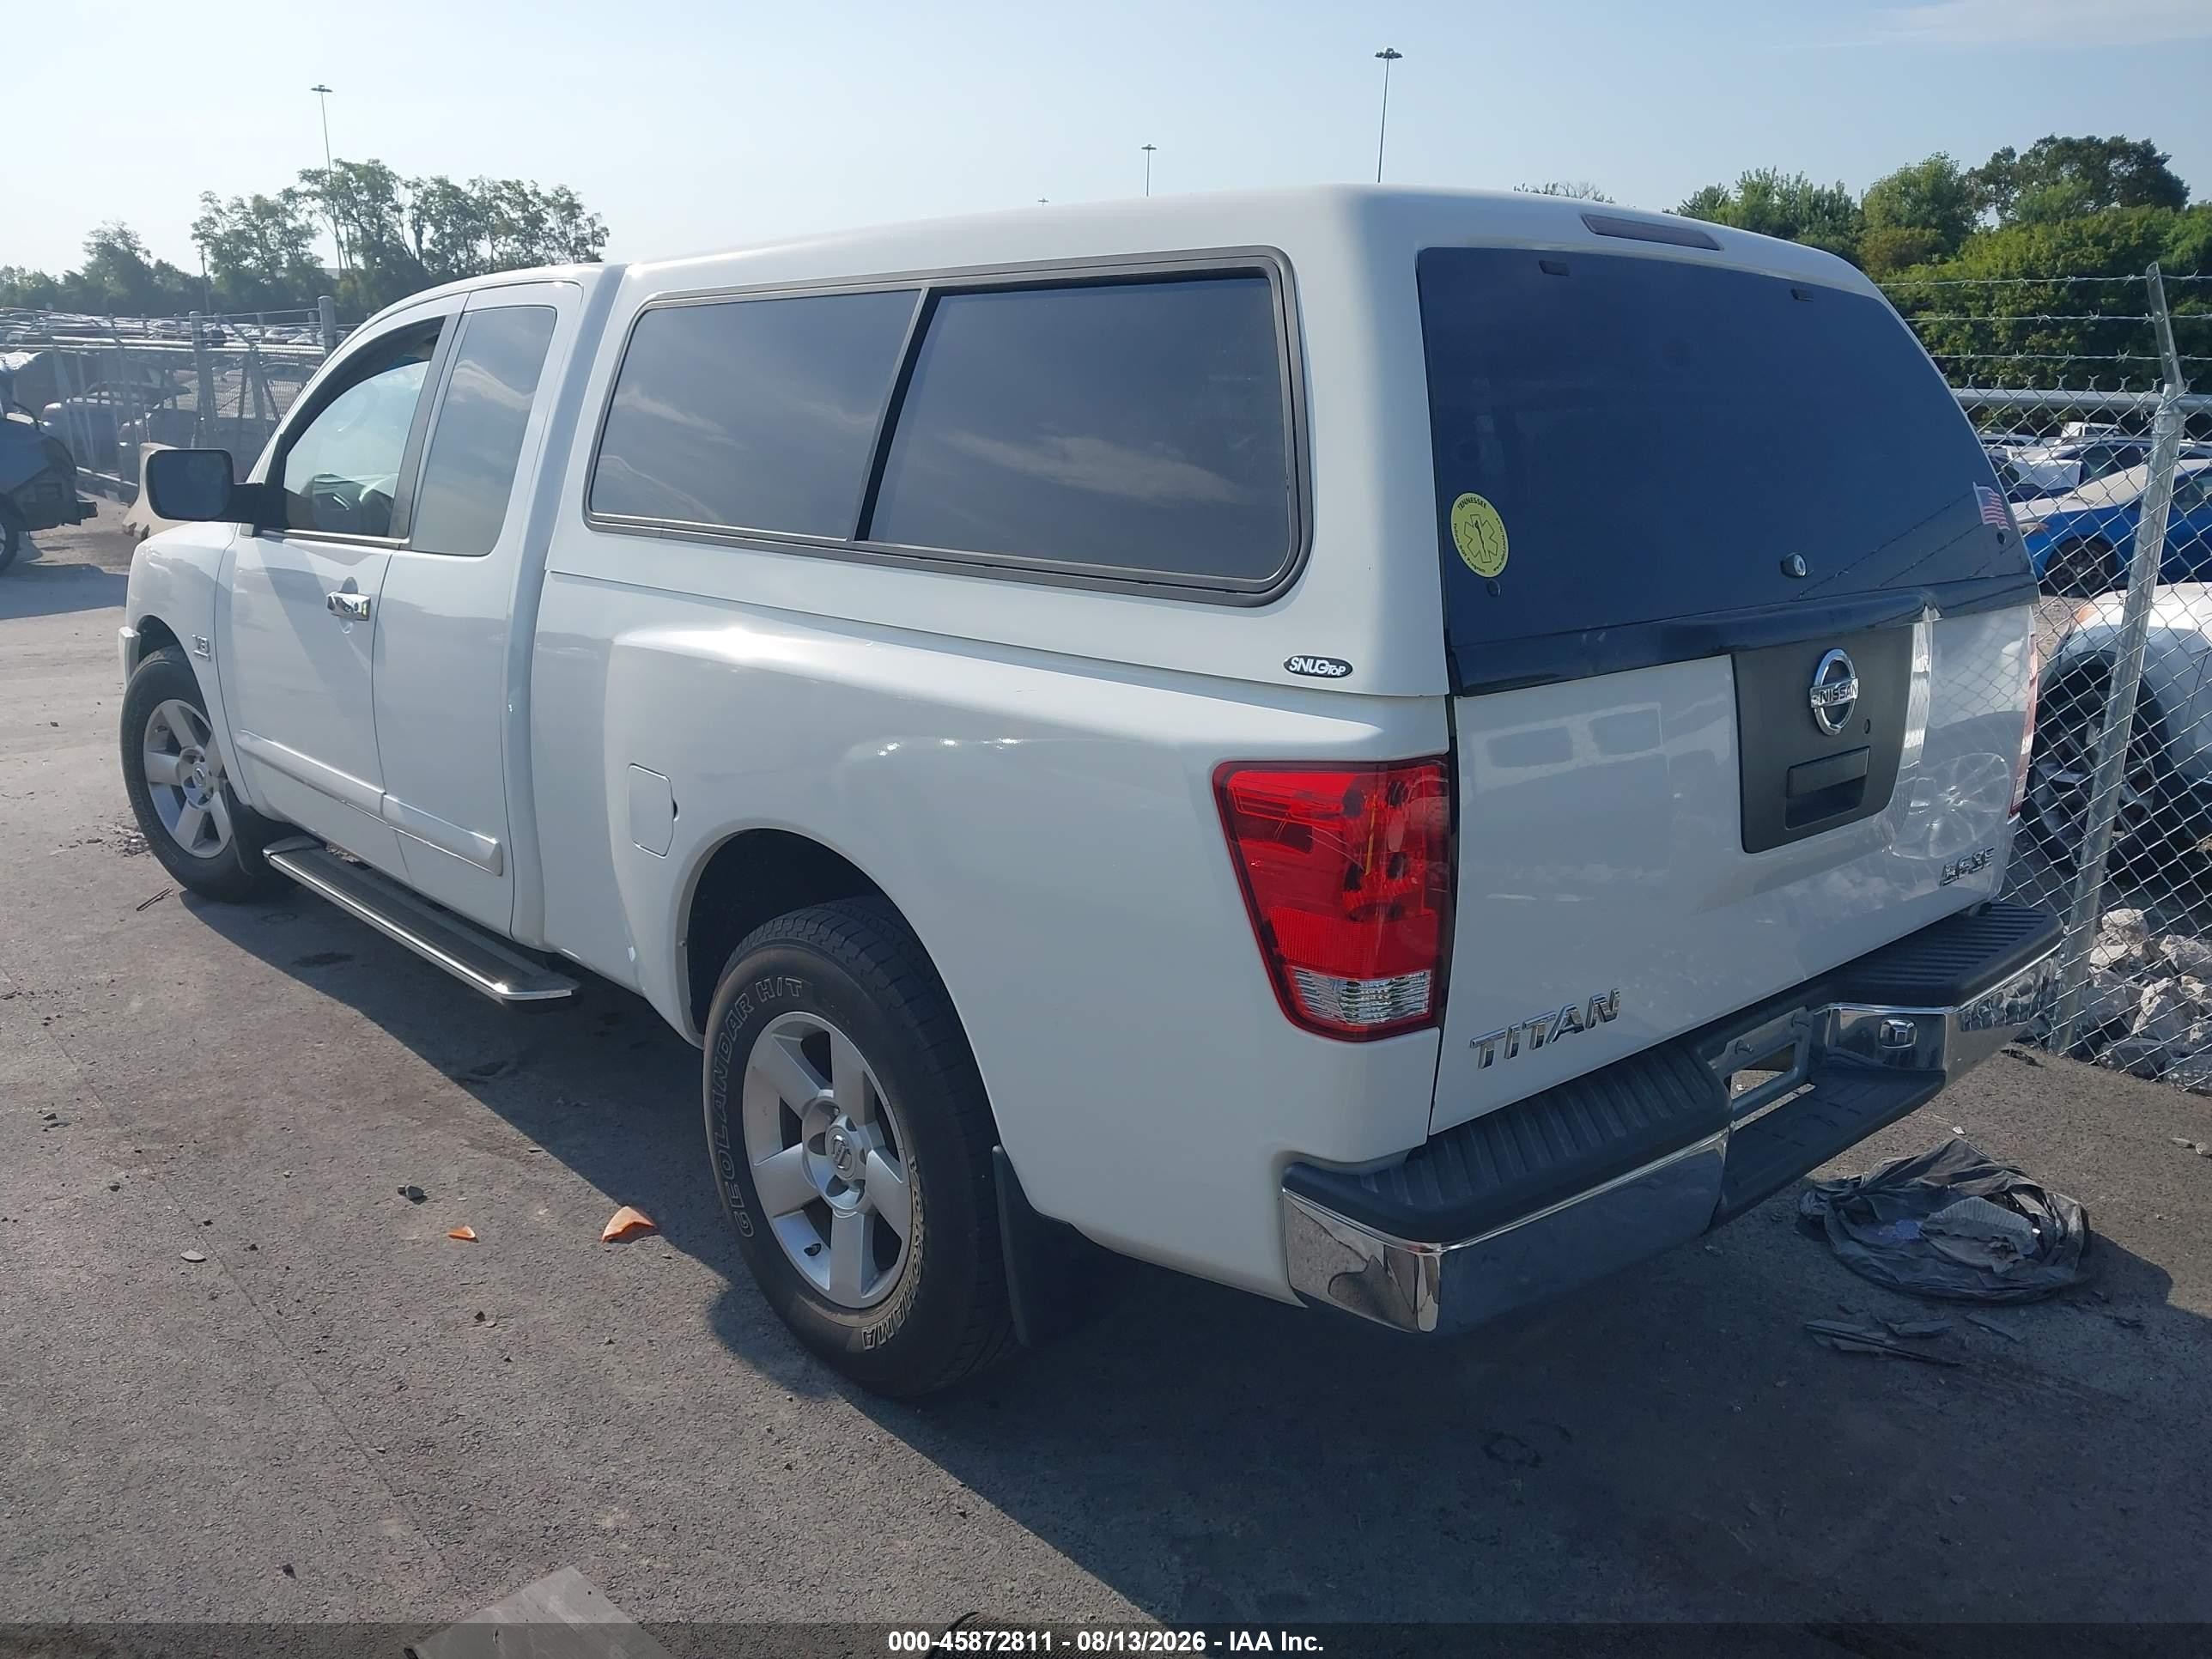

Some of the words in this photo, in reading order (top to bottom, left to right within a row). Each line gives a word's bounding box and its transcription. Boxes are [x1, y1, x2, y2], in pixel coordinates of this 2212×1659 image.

[1818, 684, 1858, 703] NISSAN
[1469, 988, 1621, 1070] TITAN
[711, 992, 755, 1239] GEOLANDAR
[755, 975, 804, 1002] H/T
